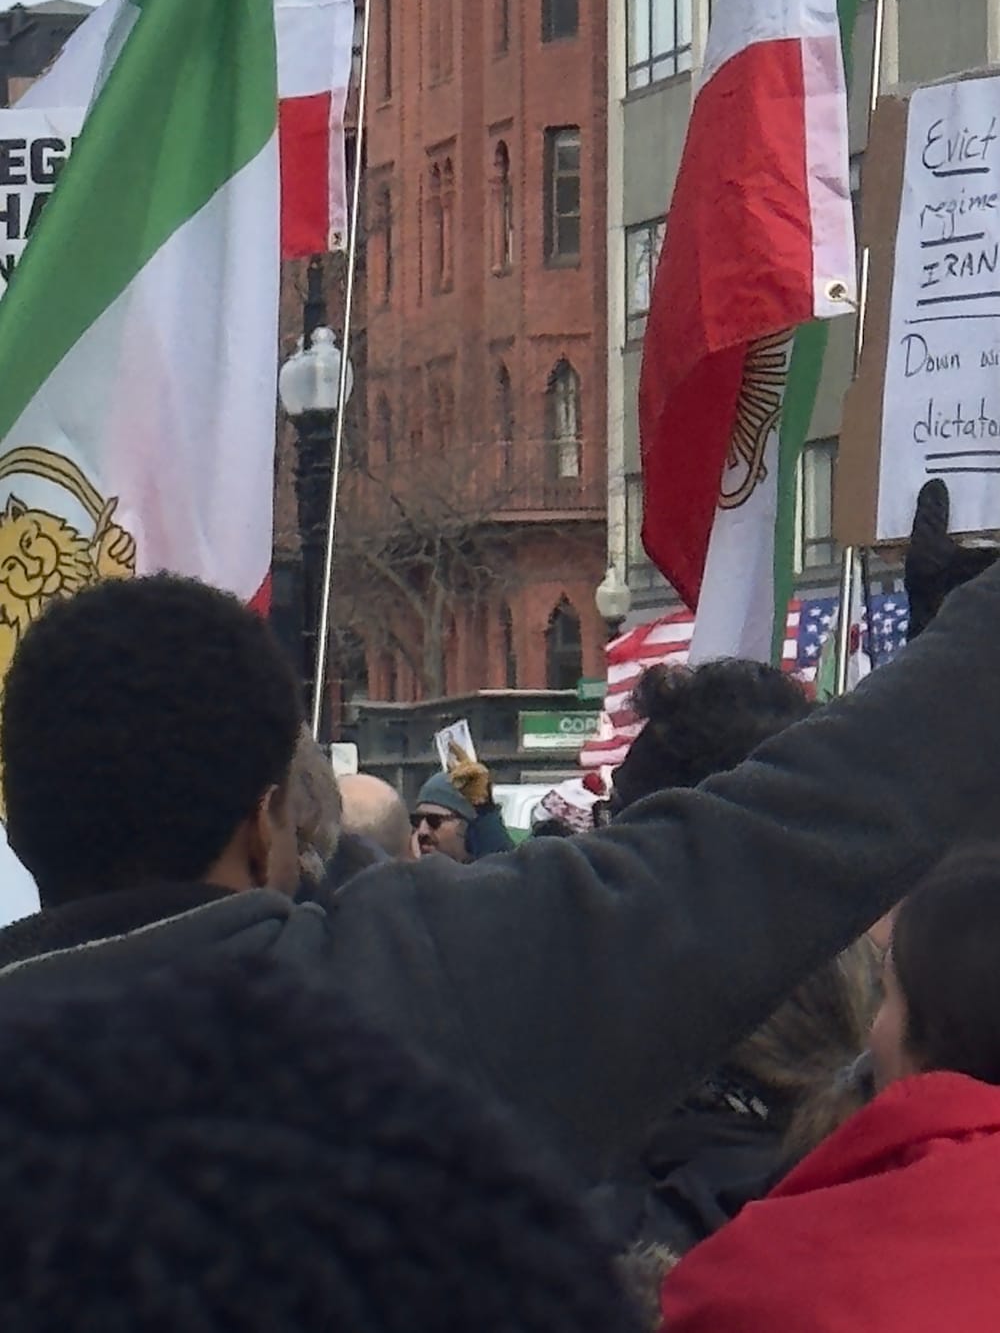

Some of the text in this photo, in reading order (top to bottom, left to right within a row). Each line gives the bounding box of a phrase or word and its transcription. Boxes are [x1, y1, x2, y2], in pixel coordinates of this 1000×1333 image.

[0, 137, 80, 185] EG
[921, 116, 999, 169] Evict
[919, 188, 999, 240] regime
[900, 332, 961, 378] Down
